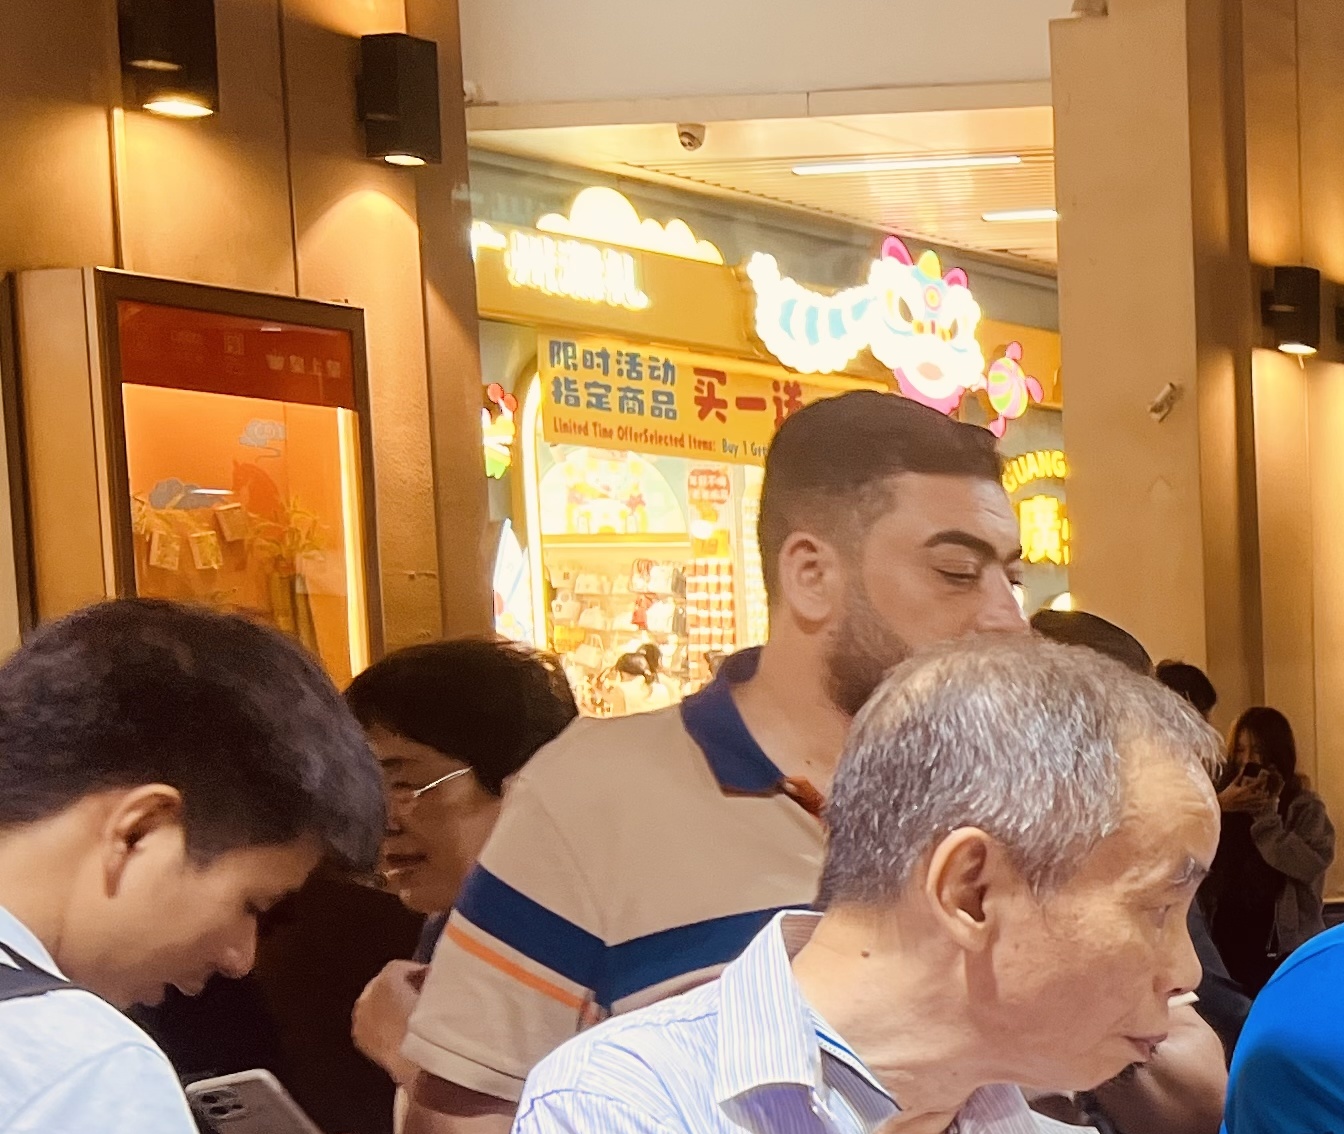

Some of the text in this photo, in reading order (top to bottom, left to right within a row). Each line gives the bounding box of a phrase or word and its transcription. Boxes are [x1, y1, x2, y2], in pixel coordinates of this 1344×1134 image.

[549, 340, 676, 386] 限时活动
[551, 376, 677, 420] 指定商品
[1002, 450, 1068, 494] GUANG
[1019, 494, 1071, 566] 廣
